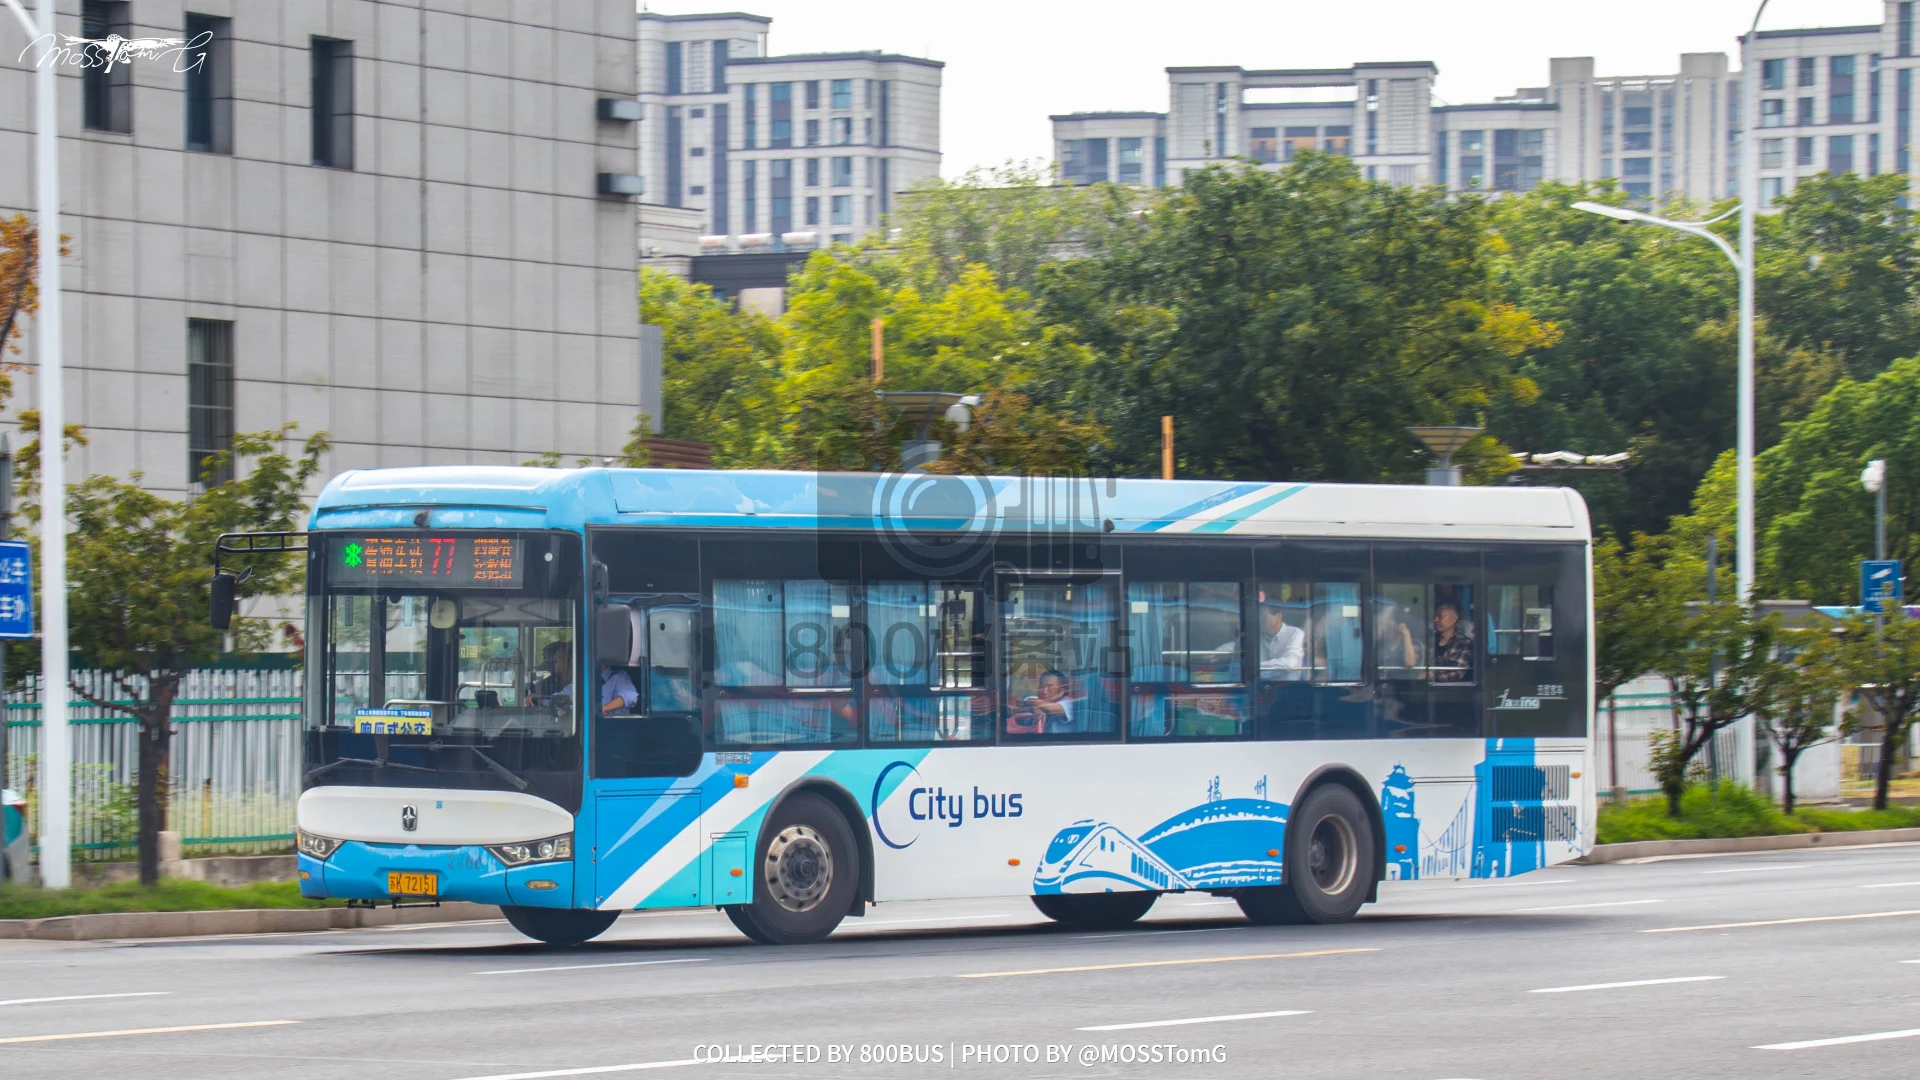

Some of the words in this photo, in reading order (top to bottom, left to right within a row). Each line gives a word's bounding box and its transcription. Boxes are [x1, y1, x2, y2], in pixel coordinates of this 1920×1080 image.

[430, 538, 456, 574] 77
[360, 721, 426, 735] 响应式公交
[909, 787, 963, 828] City
[973, 786, 1023, 819] bus
